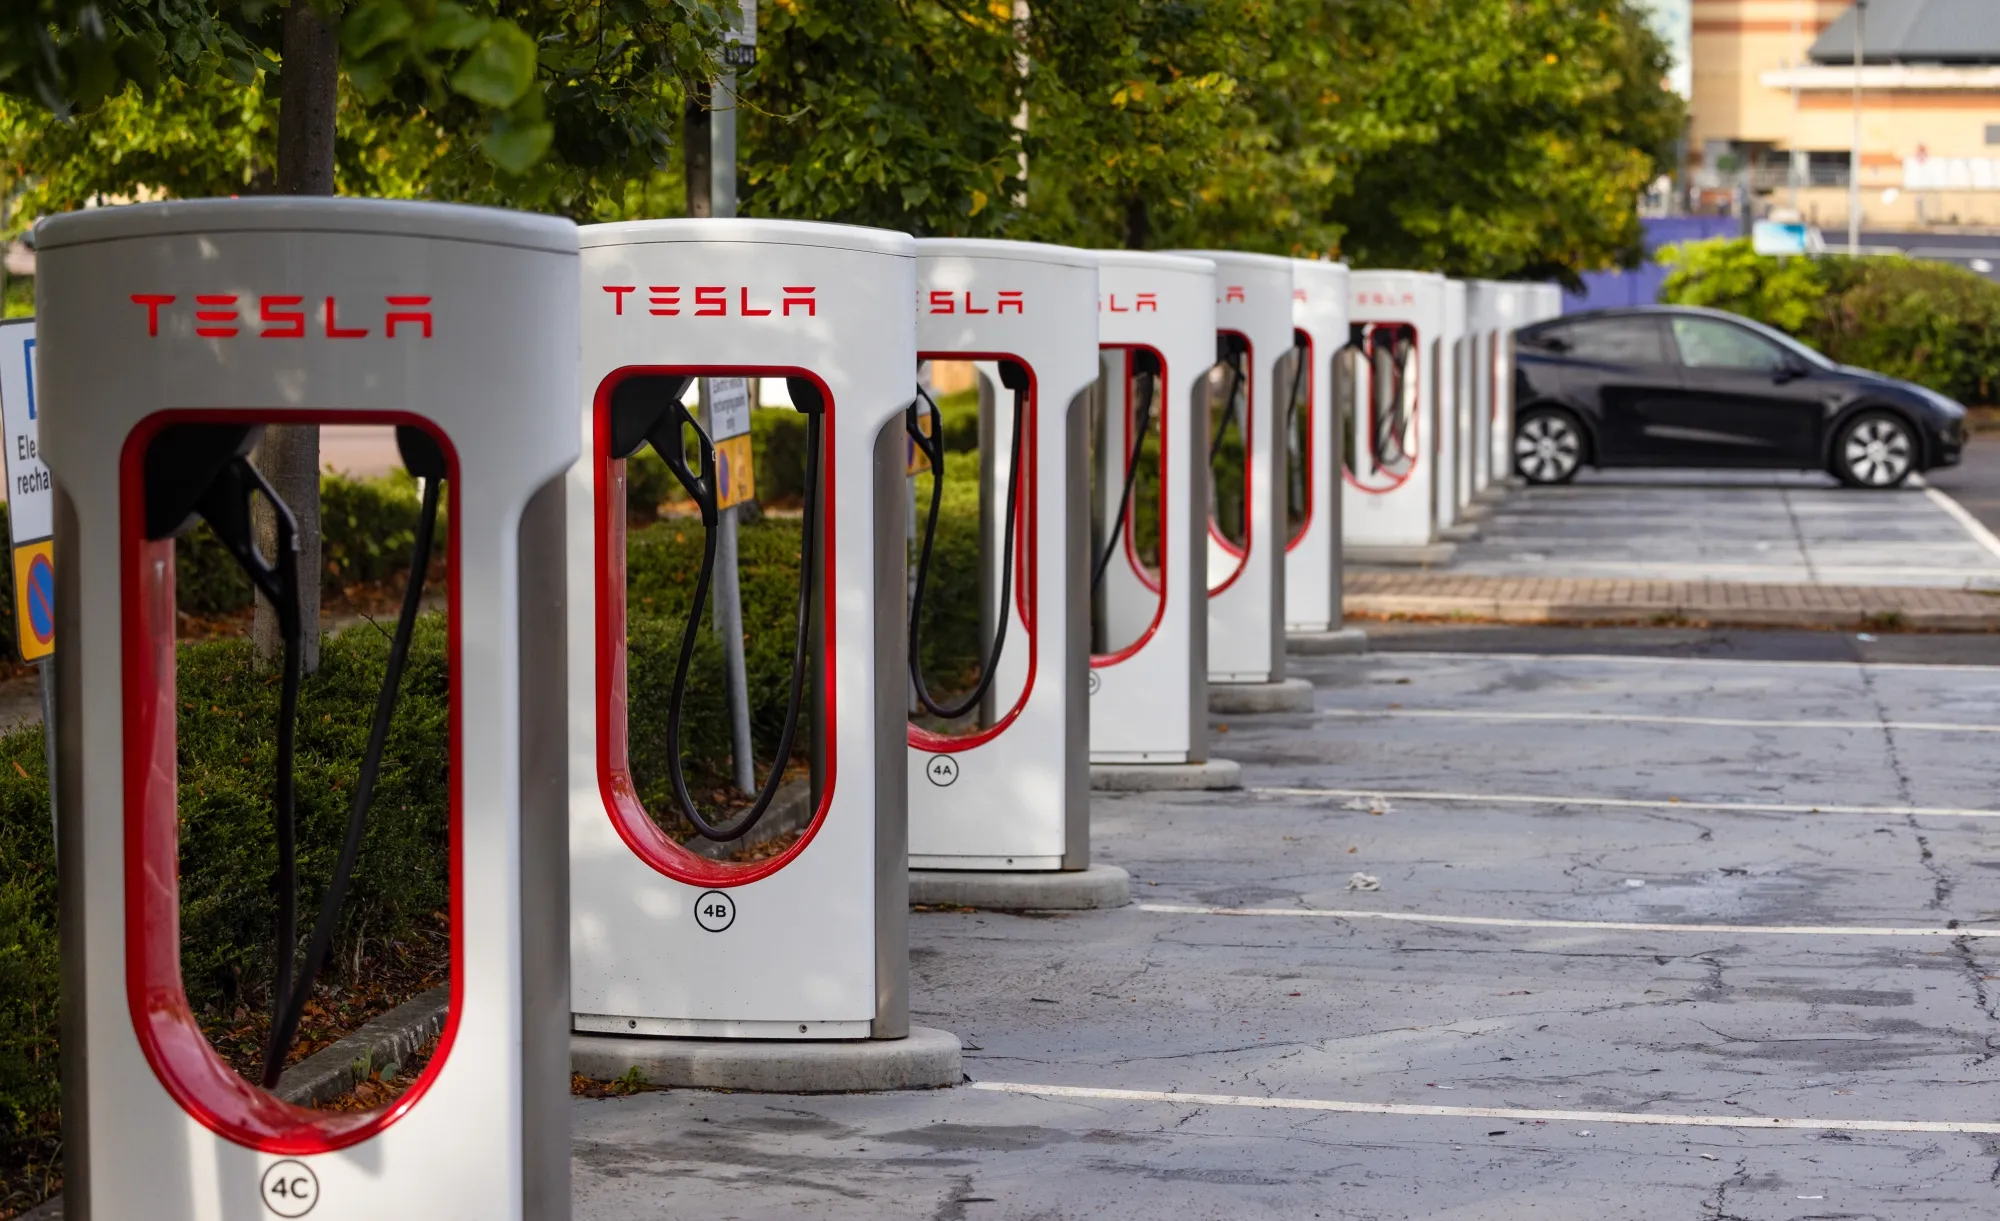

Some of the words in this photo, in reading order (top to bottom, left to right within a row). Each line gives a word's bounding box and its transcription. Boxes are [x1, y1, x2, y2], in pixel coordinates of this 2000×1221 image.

[603, 286, 817, 316] TESLA
[916, 290, 1024, 314] SLA
[130, 294, 432, 338] TESLA
[933, 764, 952, 776] 4A
[703, 904, 727, 918] 4B
[271, 1177, 308, 1199] 4C
